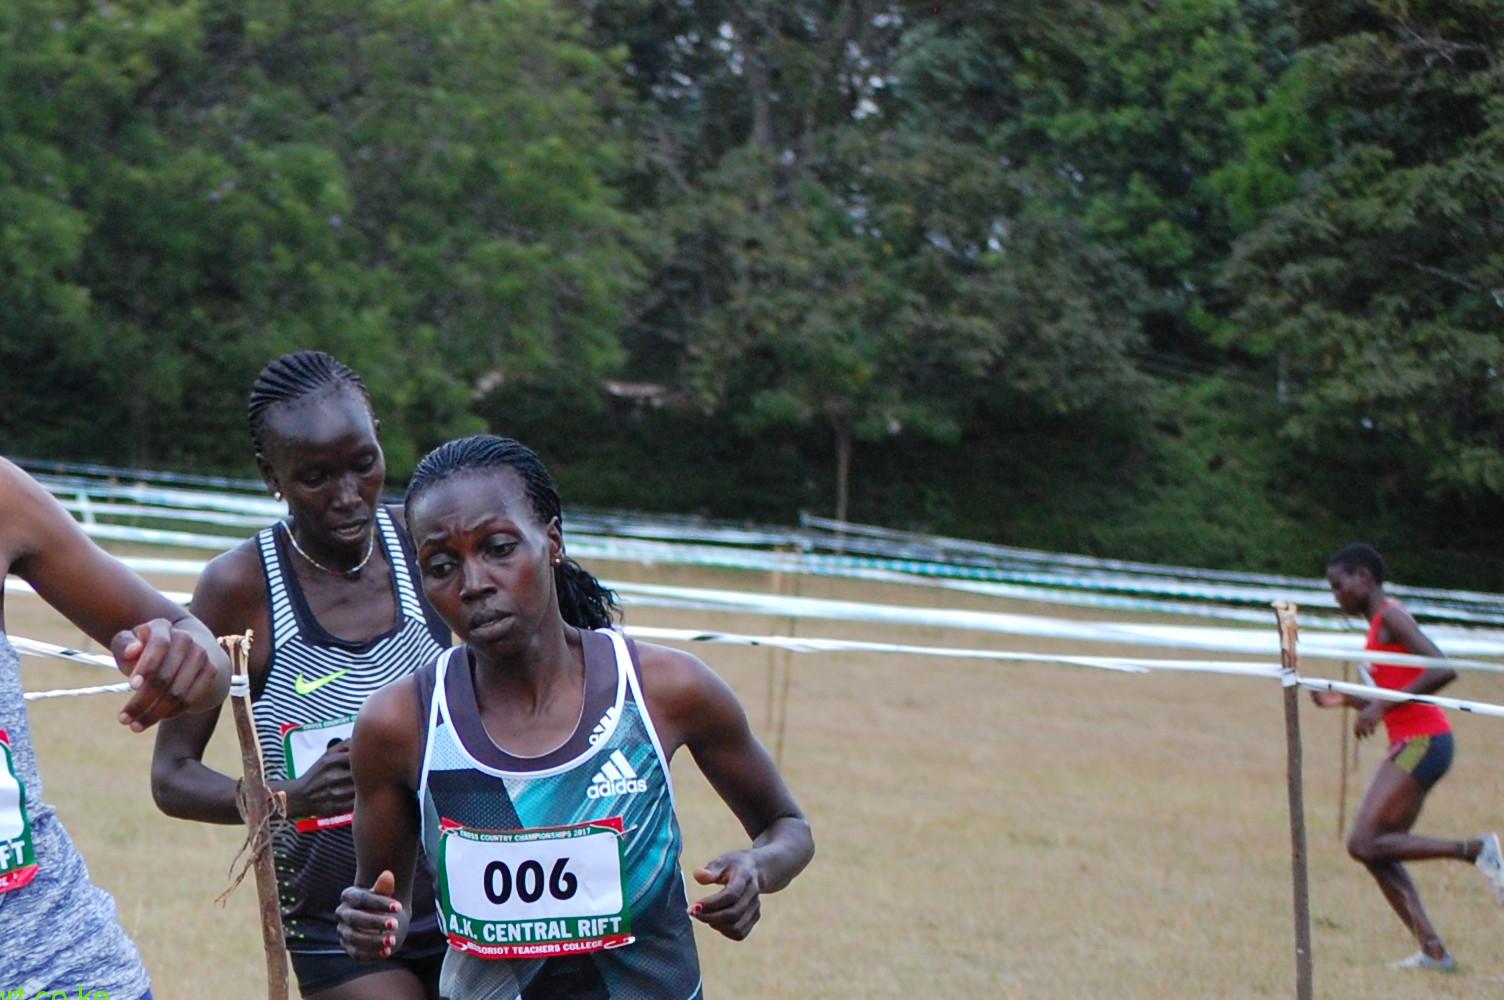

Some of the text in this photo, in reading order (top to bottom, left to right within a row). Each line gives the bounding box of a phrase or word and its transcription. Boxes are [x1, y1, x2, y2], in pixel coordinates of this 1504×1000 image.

[587, 776, 647, 799] adidas
[480, 833, 513, 842] COUNTRY
[514, 830, 572, 841] CHAMPIONSHIPS
[483, 857, 578, 905] 006
[449, 914, 622, 942] A.K. CENTRAL RIFT
[512, 944, 561, 955] TEACHERS
[563, 940, 603, 951] COLLEGE
